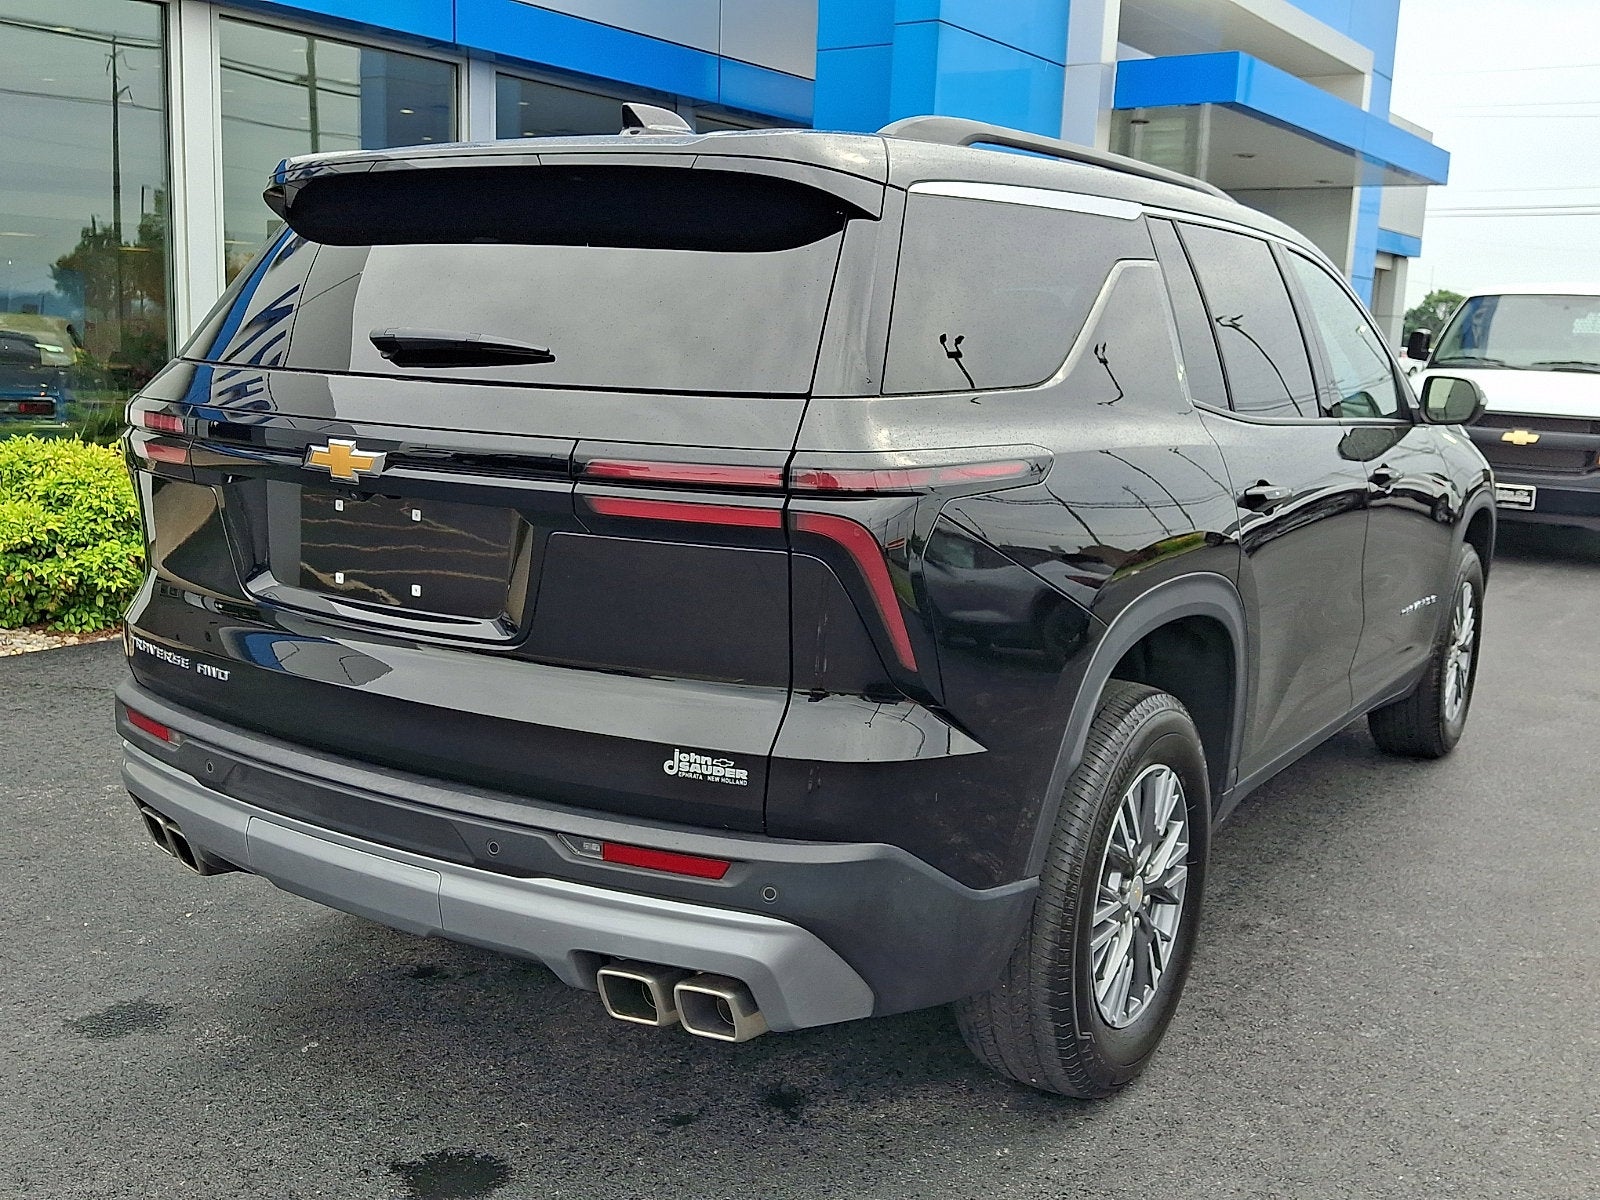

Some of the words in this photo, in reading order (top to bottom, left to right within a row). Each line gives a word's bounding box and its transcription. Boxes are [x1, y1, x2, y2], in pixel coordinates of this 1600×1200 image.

[131, 635, 191, 669] TRAVERSE
[196, 662, 231, 681] AWD
[678, 771, 703, 780] EPHRATA
[707, 775, 720, 783] NEW
[721, 777, 748, 786] HOLLAND
[679, 761, 748, 779] SAUDER
